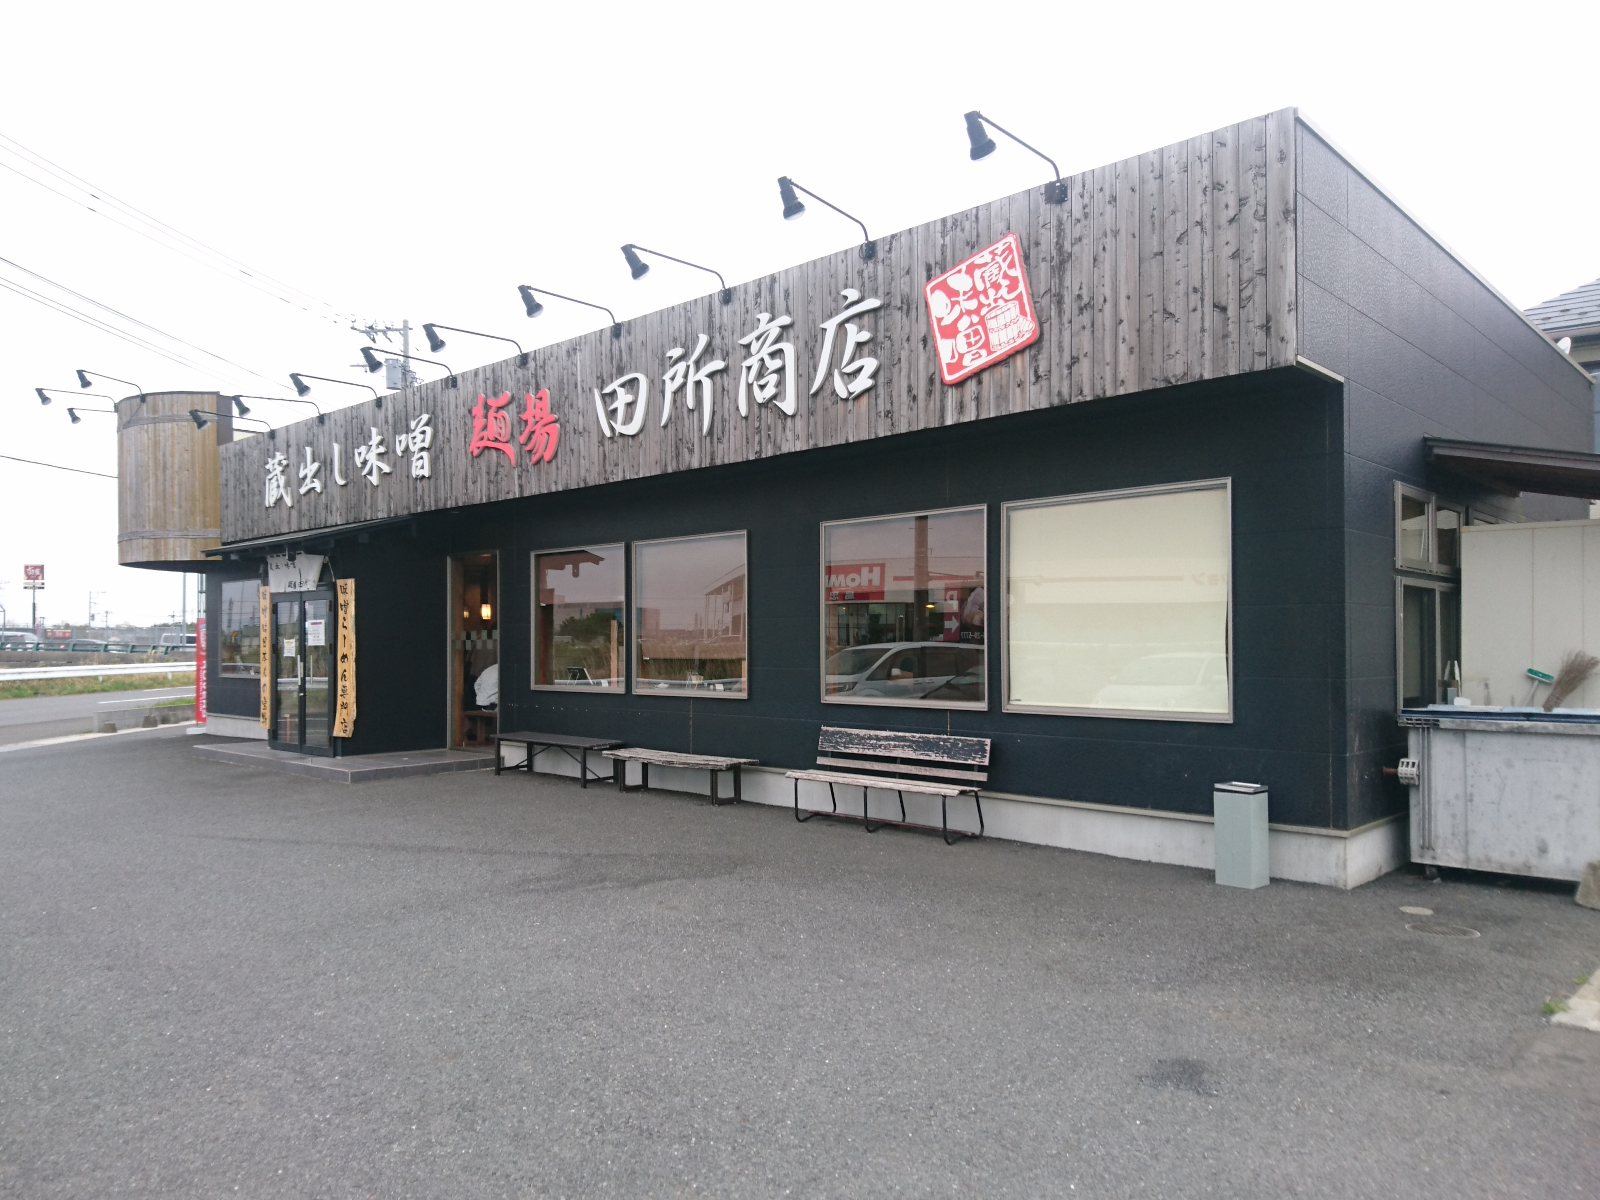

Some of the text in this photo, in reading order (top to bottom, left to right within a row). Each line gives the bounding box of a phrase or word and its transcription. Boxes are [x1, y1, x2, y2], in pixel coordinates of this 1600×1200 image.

[264, 413, 434, 508] 蔵出し味噌
[595, 288, 882, 438] 田所商店
[340, 583, 349, 734] 味噌らーめん専門店
